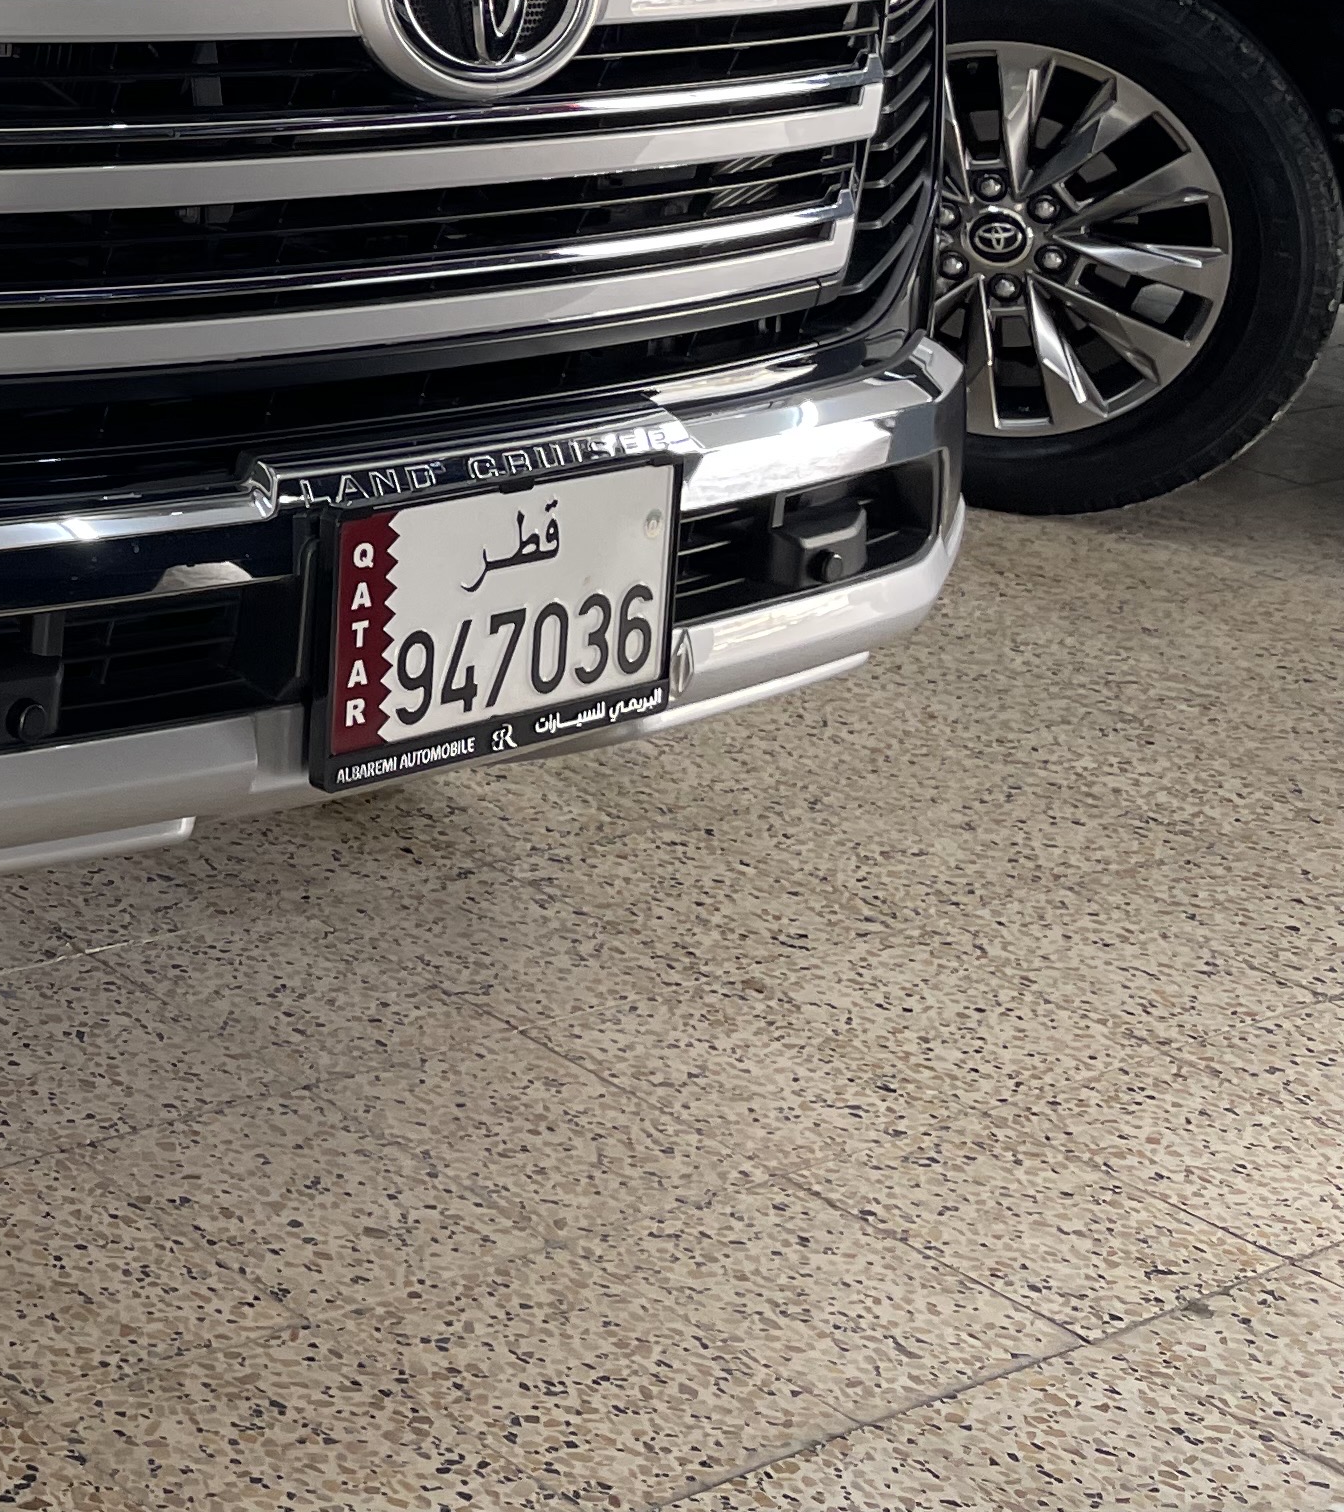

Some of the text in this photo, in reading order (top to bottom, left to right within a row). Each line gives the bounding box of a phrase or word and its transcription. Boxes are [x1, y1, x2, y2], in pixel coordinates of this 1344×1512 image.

[298, 461, 438, 508] LAND
[461, 497, 560, 592] قطر
[345, 542, 374, 728] QATAR
[395, 584, 654, 727] 947036
[336, 737, 475, 784] ALBAREMI AUTOMOBILE
